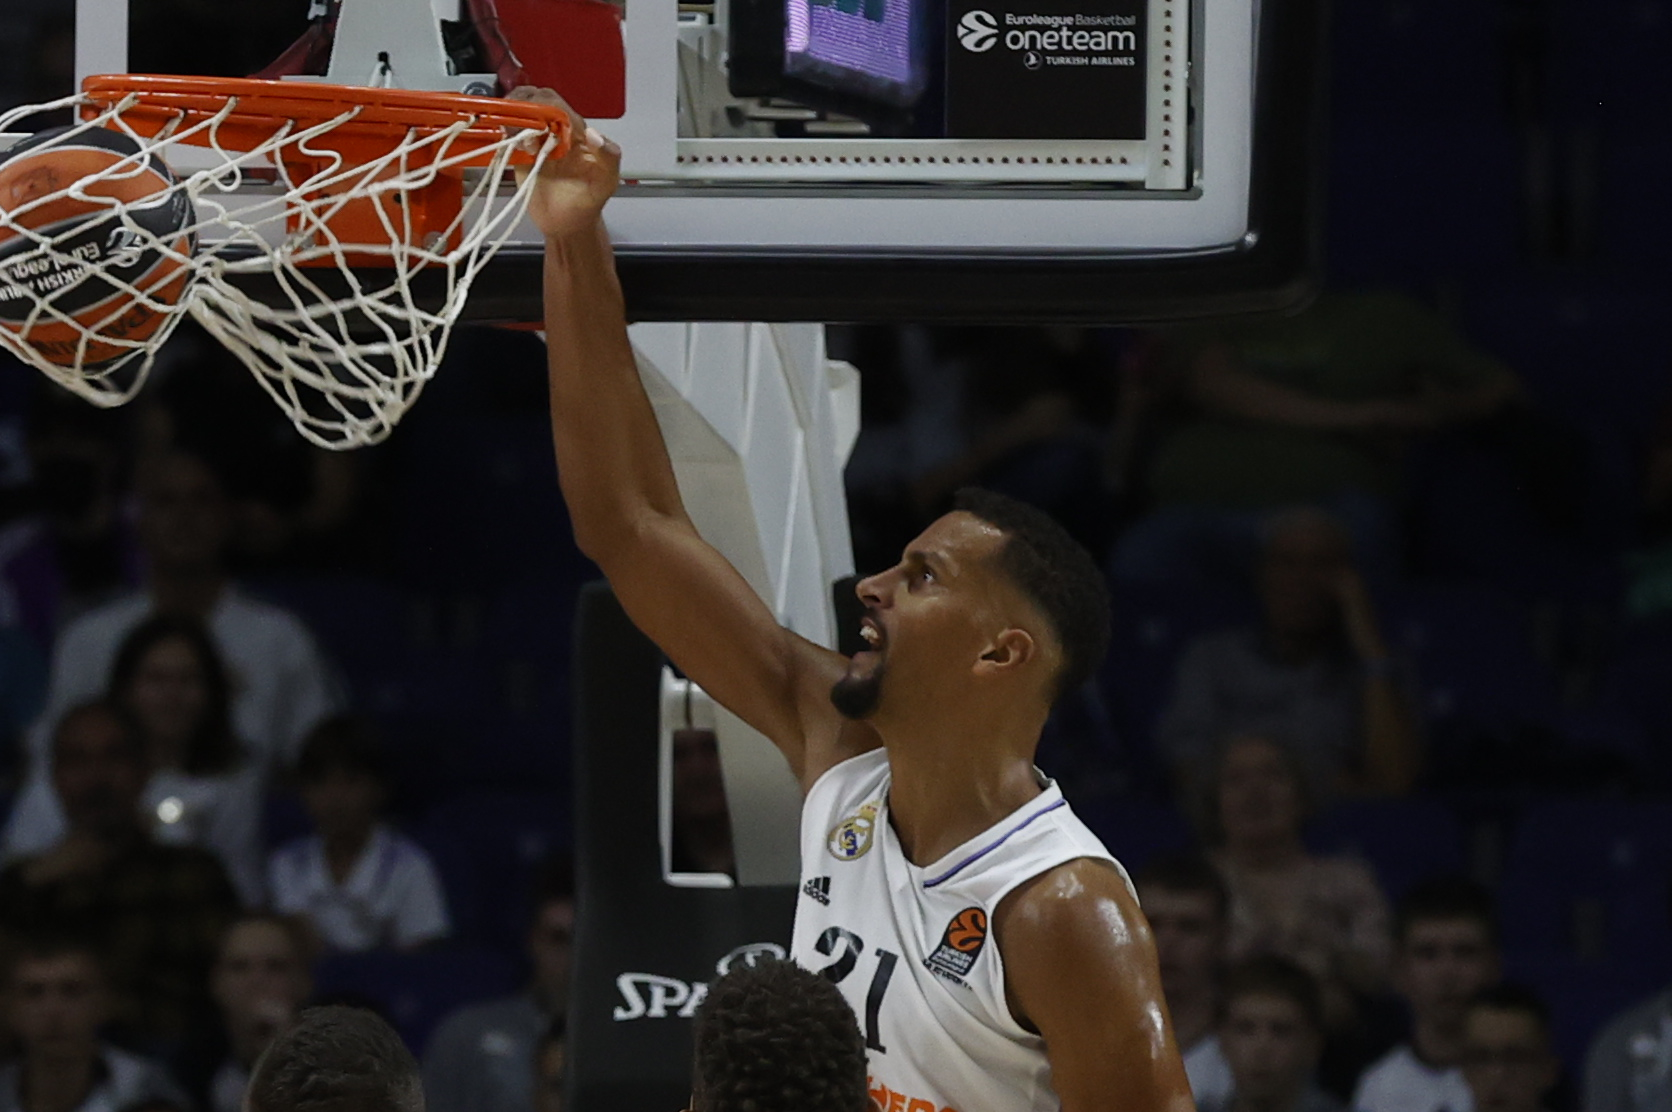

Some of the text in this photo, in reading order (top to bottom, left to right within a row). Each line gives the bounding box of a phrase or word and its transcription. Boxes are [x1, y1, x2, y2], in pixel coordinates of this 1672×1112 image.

[1005, 13, 1136, 28] Euroleague Basketball
[1005, 27, 1136, 51] oneteam
[1045, 56, 1135, 66] TURKISH AIRLINES
[814, 926, 899, 1055] 21
